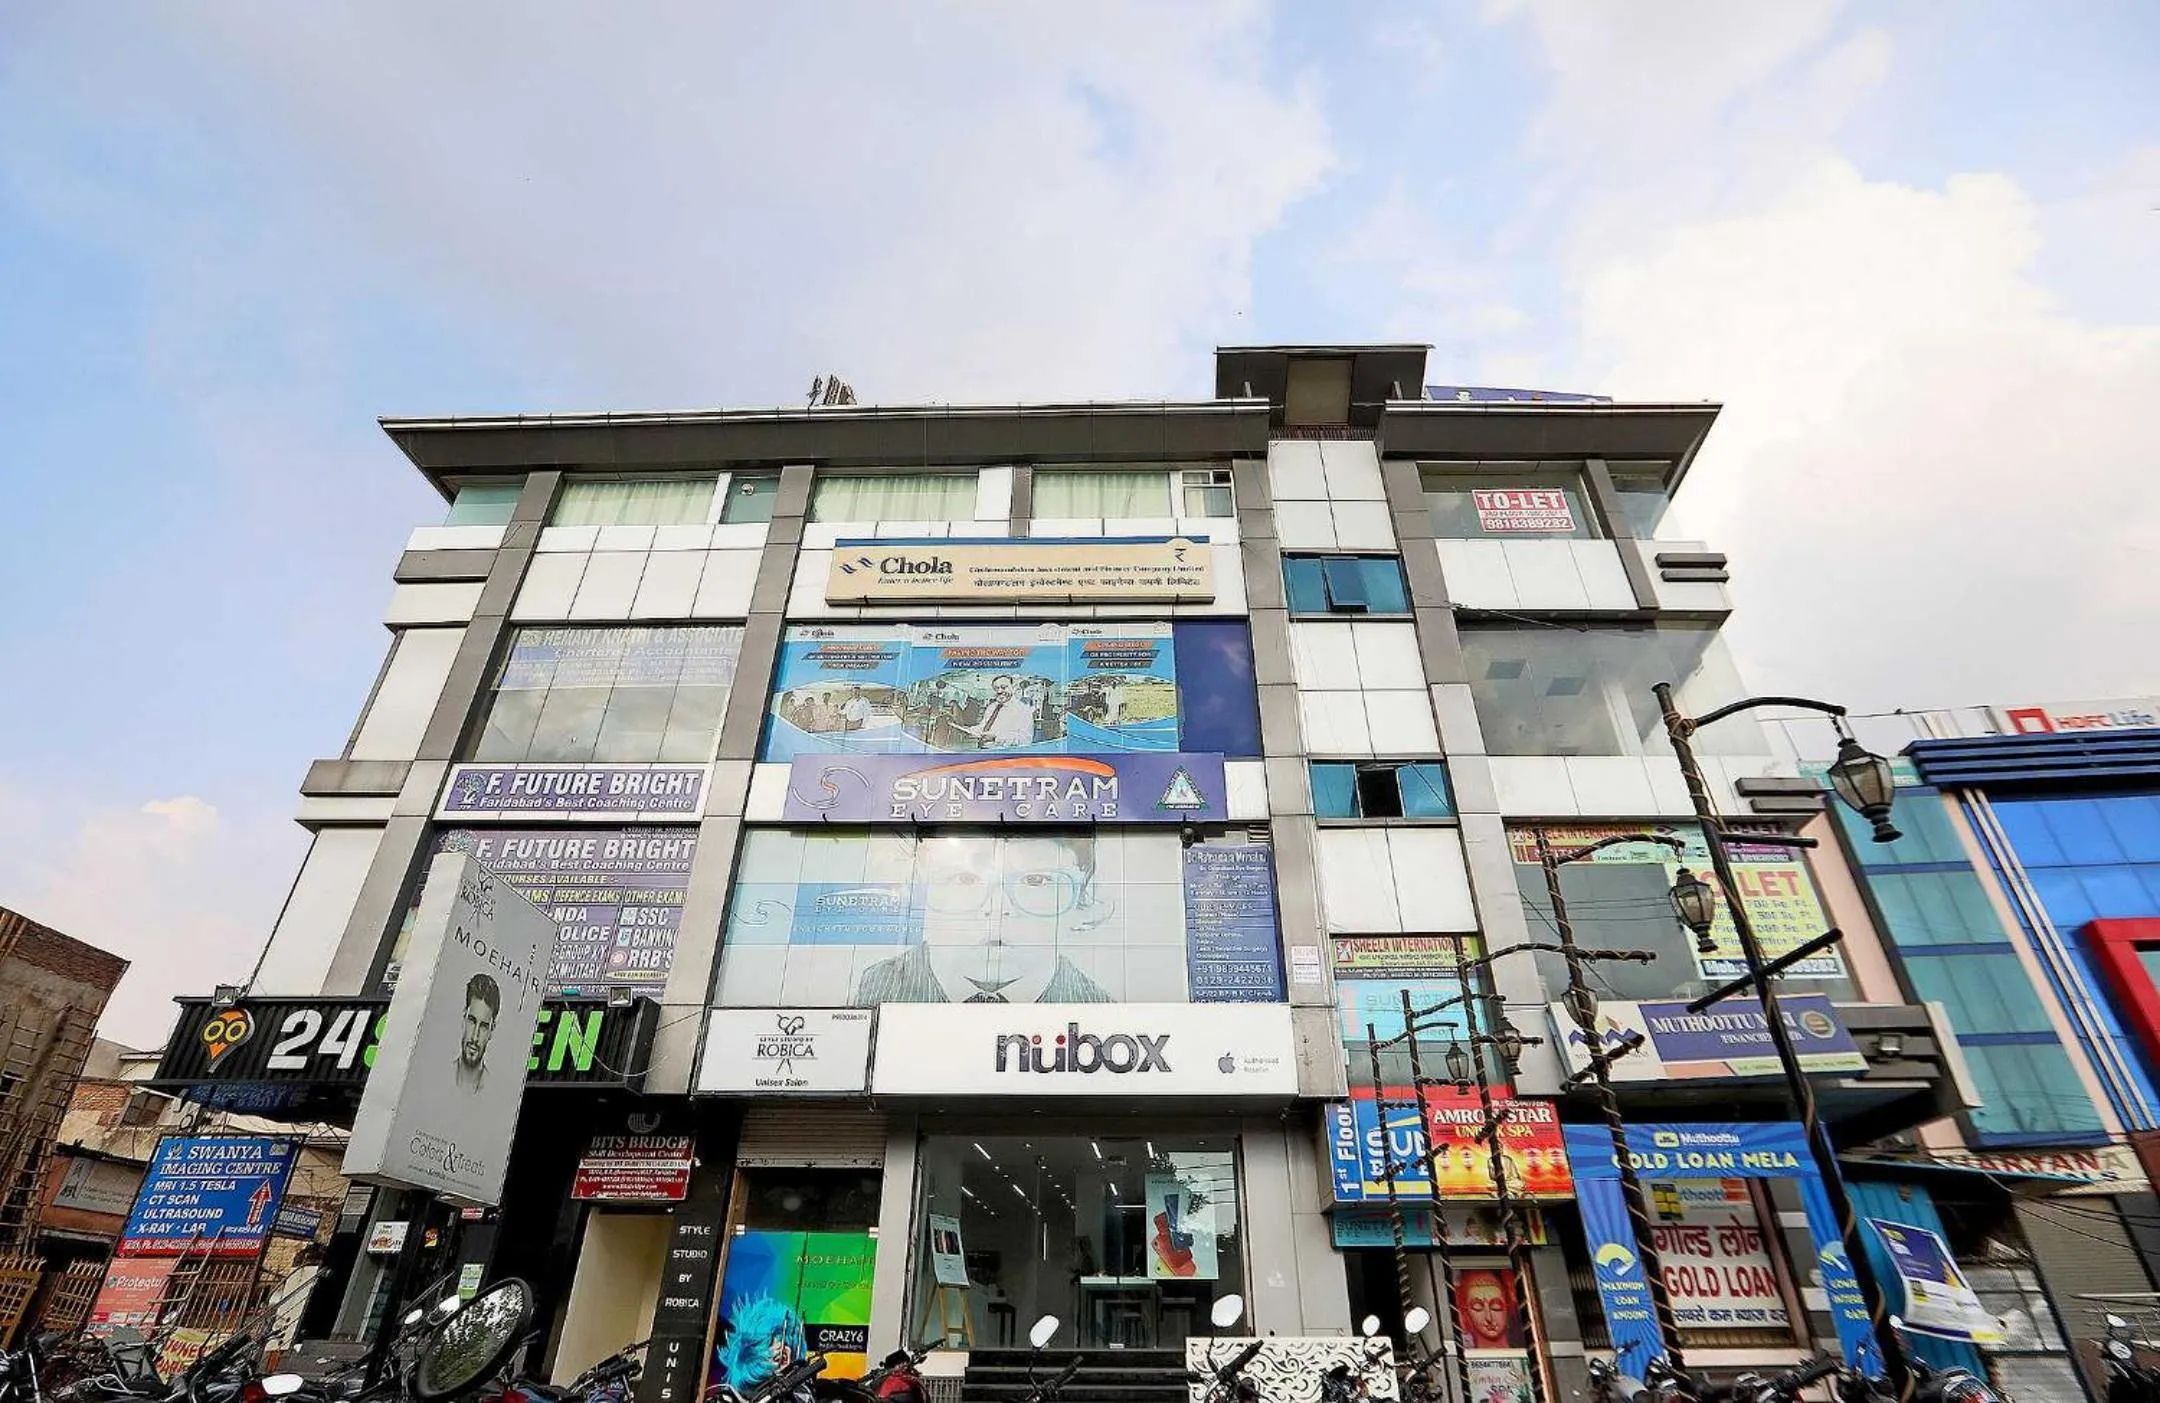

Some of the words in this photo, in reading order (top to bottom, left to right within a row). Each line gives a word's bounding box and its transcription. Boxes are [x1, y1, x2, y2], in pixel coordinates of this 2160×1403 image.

[1477, 492, 1559, 509] TO-LET
[880, 556, 953, 574] Chola
[555, 647, 631, 659] Chartered
[486, 773, 501, 795] F.
[510, 773, 604, 795] FUTURE
[609, 772, 699, 794] BRIGHT
[892, 776, 1119, 801] SUNETRAM
[479, 797, 551, 809] Faridabad's
[555, 797, 585, 809] Best
[588, 798, 646, 811] Coaching
[649, 799, 692, 809] Centre
[890, 803, 962, 818] EYE
[1016, 803, 1119, 818] CARE
[475, 839, 493, 859] F.
[501, 839, 597, 859] FUTURE
[603, 839, 697, 859] BRIGHT
[480, 859, 547, 870] aridabad's
[551, 859, 580, 870] Best
[583, 859, 643, 872] Coaching
[646, 860, 690, 870] Centre
[503, 875, 546, 884] OURSES
[549, 875, 607, 884] AVAILABLE
[1701, 871, 1724, 898] O
[1737, 871, 1799, 897] LET
[555, 889, 593, 903] DEFENCE
[594, 889, 621, 903] EXAMS
[625, 890, 656, 903] OTHER
[815, 895, 900, 907] SUNETRAM
[554, 907, 588, 921] NDA
[638, 907, 671, 926] SSC
[559, 926, 610, 941] OLICE
[632, 928, 680, 947] BANKIN
[560, 945, 592, 960] GROUP
[1353, 938, 1389, 953] SHEELA
[1651, 1013, 1755, 1034] MUTHOOTTU
[757, 1043, 815, 1057] ROBICA
[755, 1078, 783, 1087] Unisex
[1507, 1108, 1553, 1123] STAR
[1337, 1102, 1355, 1161] Floor
[1508, 1124, 1535, 1138] SPA
[591, 1136, 626, 1149] BITS
[629, 1136, 690, 1149] BRIDGE
[188, 1145, 263, 1160] SWANYA
[443, 1142, 456, 1174] &
[1676, 1152, 1736, 1169] LOAN
[1741, 1151, 1800, 1169] MELA
[1951, 1150, 2130, 1172] ARYANA
[160, 1162, 223, 1175] IMAGING
[225, 1161, 283, 1175] CENTRE
[154, 1180, 179, 1192] MRI
[180, 1181, 198, 1191] 1.5
[200, 1180, 237, 1191] TESLA
[149, 1194, 167, 1205] CT
[166, 1194, 201, 1204] SCAN
[143, 1208, 224, 1220] ULTRASOUND
[137, 1222, 172, 1234] X-RAY
[680, 1226, 712, 1235] STYLE
[672, 1249, 708, 1259] STUDIO
[678, 1274, 692, 1283] BY
[1663, 1266, 1720, 1297] GOLD
[1602, 1281, 1645, 1291] MAXIMUM
[665, 1297, 700, 1308] ROBICA
[1614, 1296, 1640, 1305] LOAN
[1612, 1310, 1648, 1320] AMOUNT
[819, 1329, 864, 1343] CRAZY6
